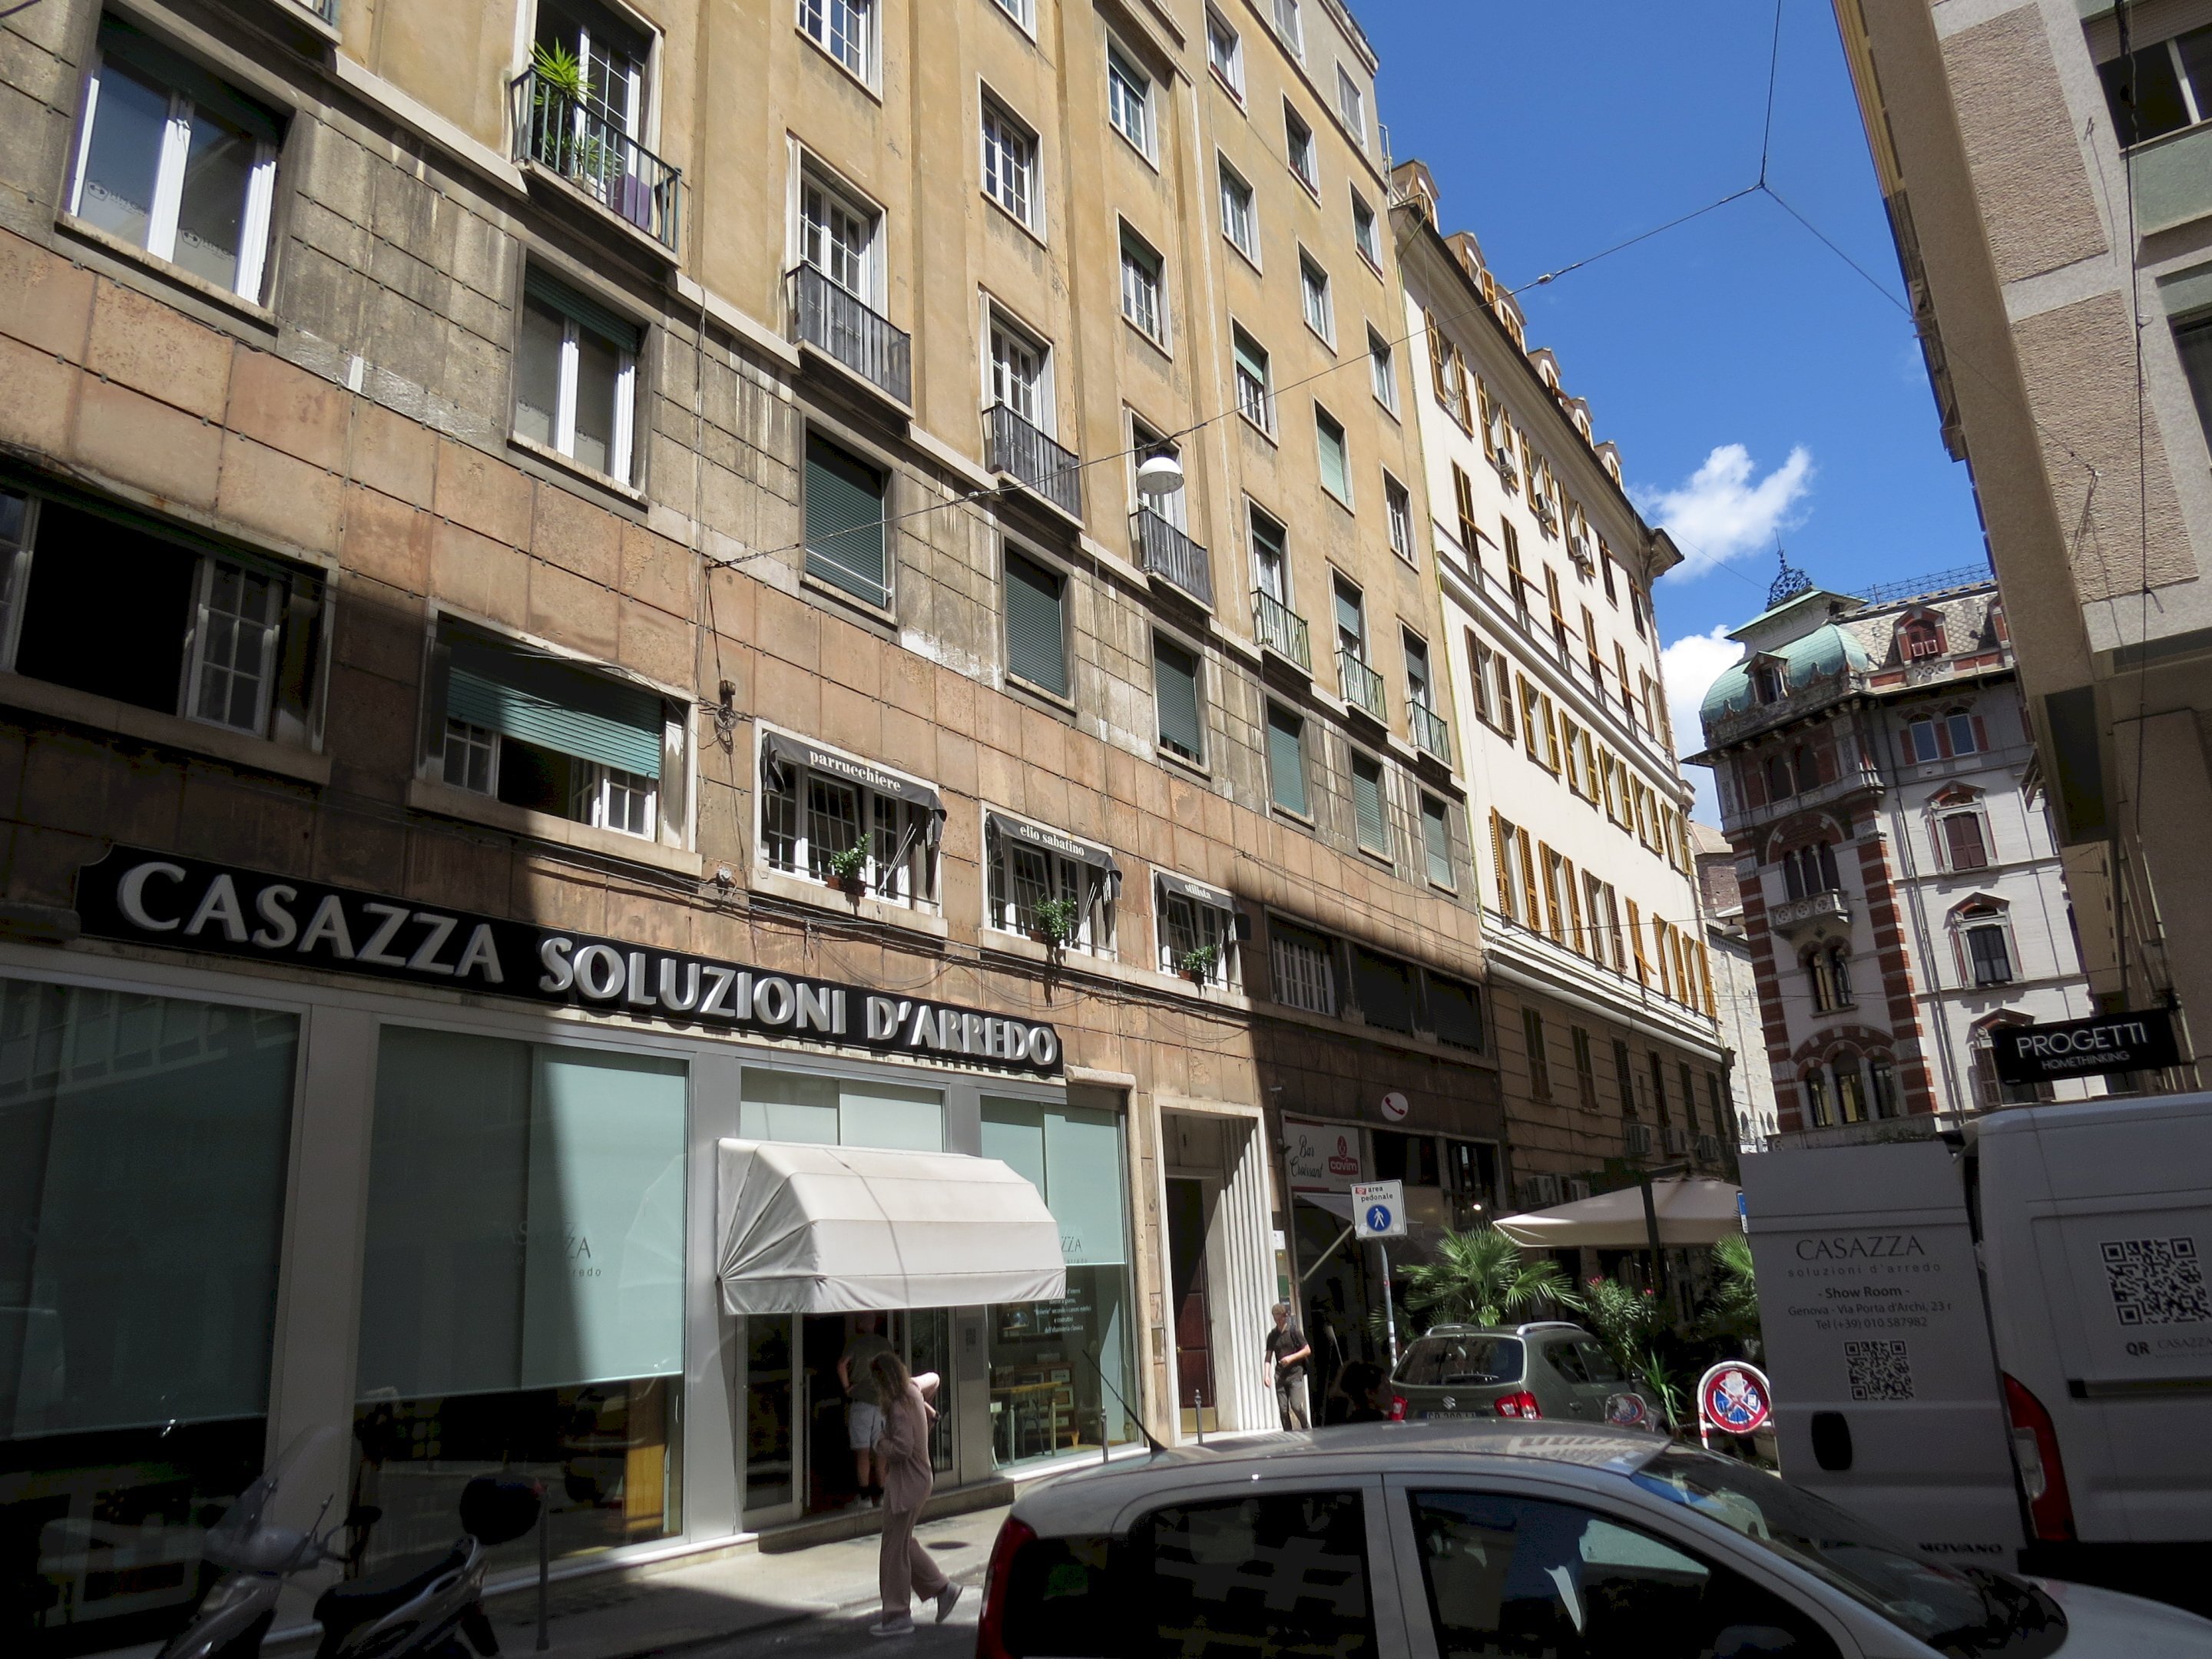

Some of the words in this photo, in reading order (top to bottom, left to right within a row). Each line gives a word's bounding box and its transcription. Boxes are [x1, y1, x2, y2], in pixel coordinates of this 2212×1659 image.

[810, 750, 902, 793] parrucchiere
[1020, 825, 1040, 841] elio
[1042, 832, 1085, 856] sabatino
[1184, 882, 1212, 900] stilista
[117, 861, 504, 983] CASAZZA
[539, 936, 847, 1035] SOLUZIONI
[866, 995, 1059, 1065] D'ARREDO
[2016, 1022, 2148, 1058] PROGETTI
[2041, 1051, 2130, 1070] HOMETHINKING
[1299, 1134, 1314, 1157] Bar
[1290, 1156, 1323, 1178] Croissant
[1330, 1158, 1358, 1171] covim
[1361, 1193, 1393, 1203] pedonale
[1796, 1234, 1926, 1260] CASAZZA
[1788, 1266, 1862, 1277] soluzioni
[1869, 1262, 1941, 1273] d'arredo
[1825, 1286, 1860, 1299] Show
[1864, 1286, 1902, 1297] Room
[1788, 1306, 1829, 1316] Genova
[1837, 1304, 1854, 1315] Via
[1856, 1303, 1885, 1313] Porta
[1931, 1300, 1945, 1311] 23
[1815, 1320, 1830, 1330] Tel
[1833, 1318, 1862, 1330] (+39)
[1864, 1317, 1883, 1328] 010
[1887, 1316, 1927, 1328] 587982
[2125, 1341, 2150, 1356] QR
